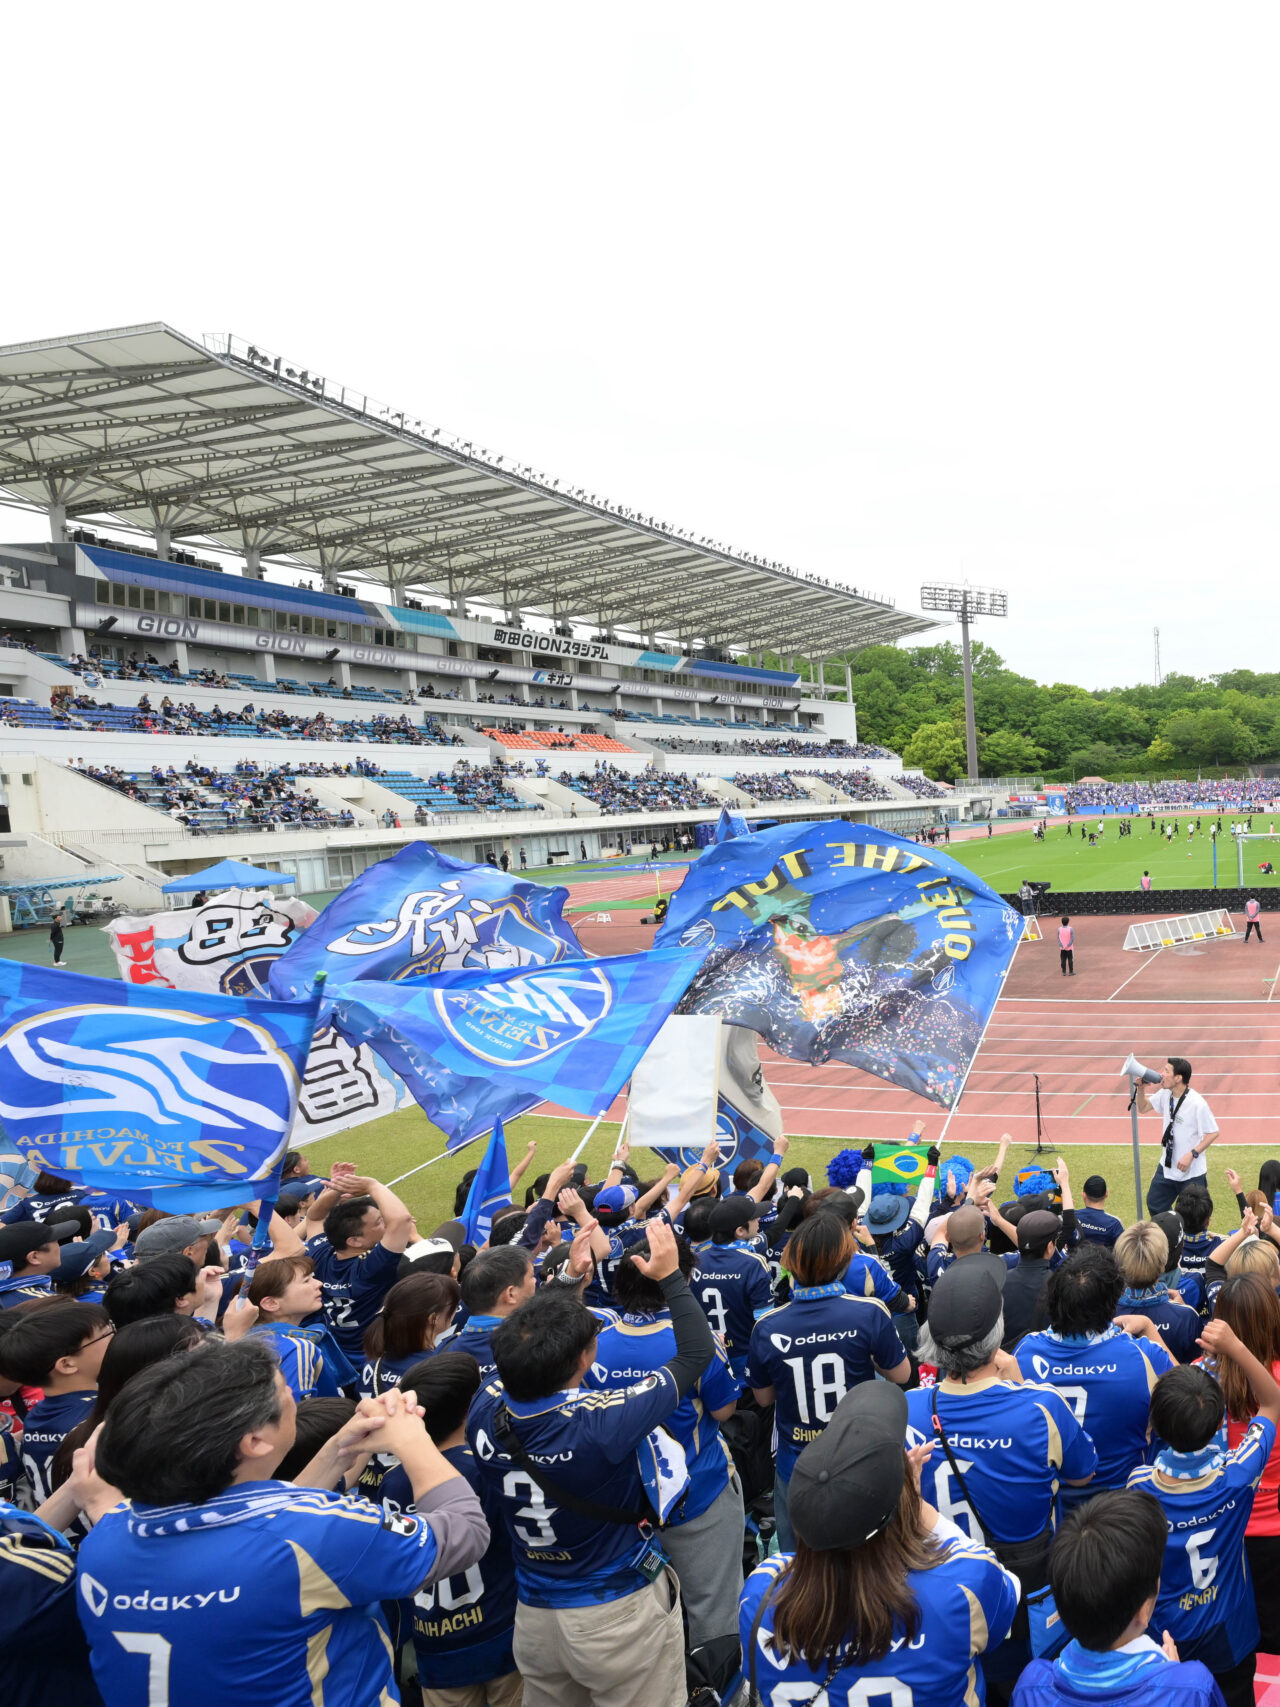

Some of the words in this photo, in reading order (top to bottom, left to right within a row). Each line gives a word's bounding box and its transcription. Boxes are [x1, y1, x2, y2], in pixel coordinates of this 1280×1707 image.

[136, 615, 199, 639] GION
[255, 634, 307, 653] GION
[493, 628, 610, 661] 町田GIONスタジアム
[353, 650, 397, 665] GION
[720, 692, 743, 704] GION
[762, 697, 784, 709] GION
[702, 1271, 742, 1281] odakyu
[794, 1329, 858, 1347] odakyu
[1051, 1363, 1117, 1376] odakyu
[783, 1352, 850, 1425] 18
[502, 1470, 559, 1547] 3
[1176, 1500, 1237, 1530] odakyu
[1184, 1527, 1219, 1591] 6
[112, 1586, 241, 1612] odakyu
[1178, 1584, 1219, 1612] HENRY
[111, 1630, 173, 1707] 7
